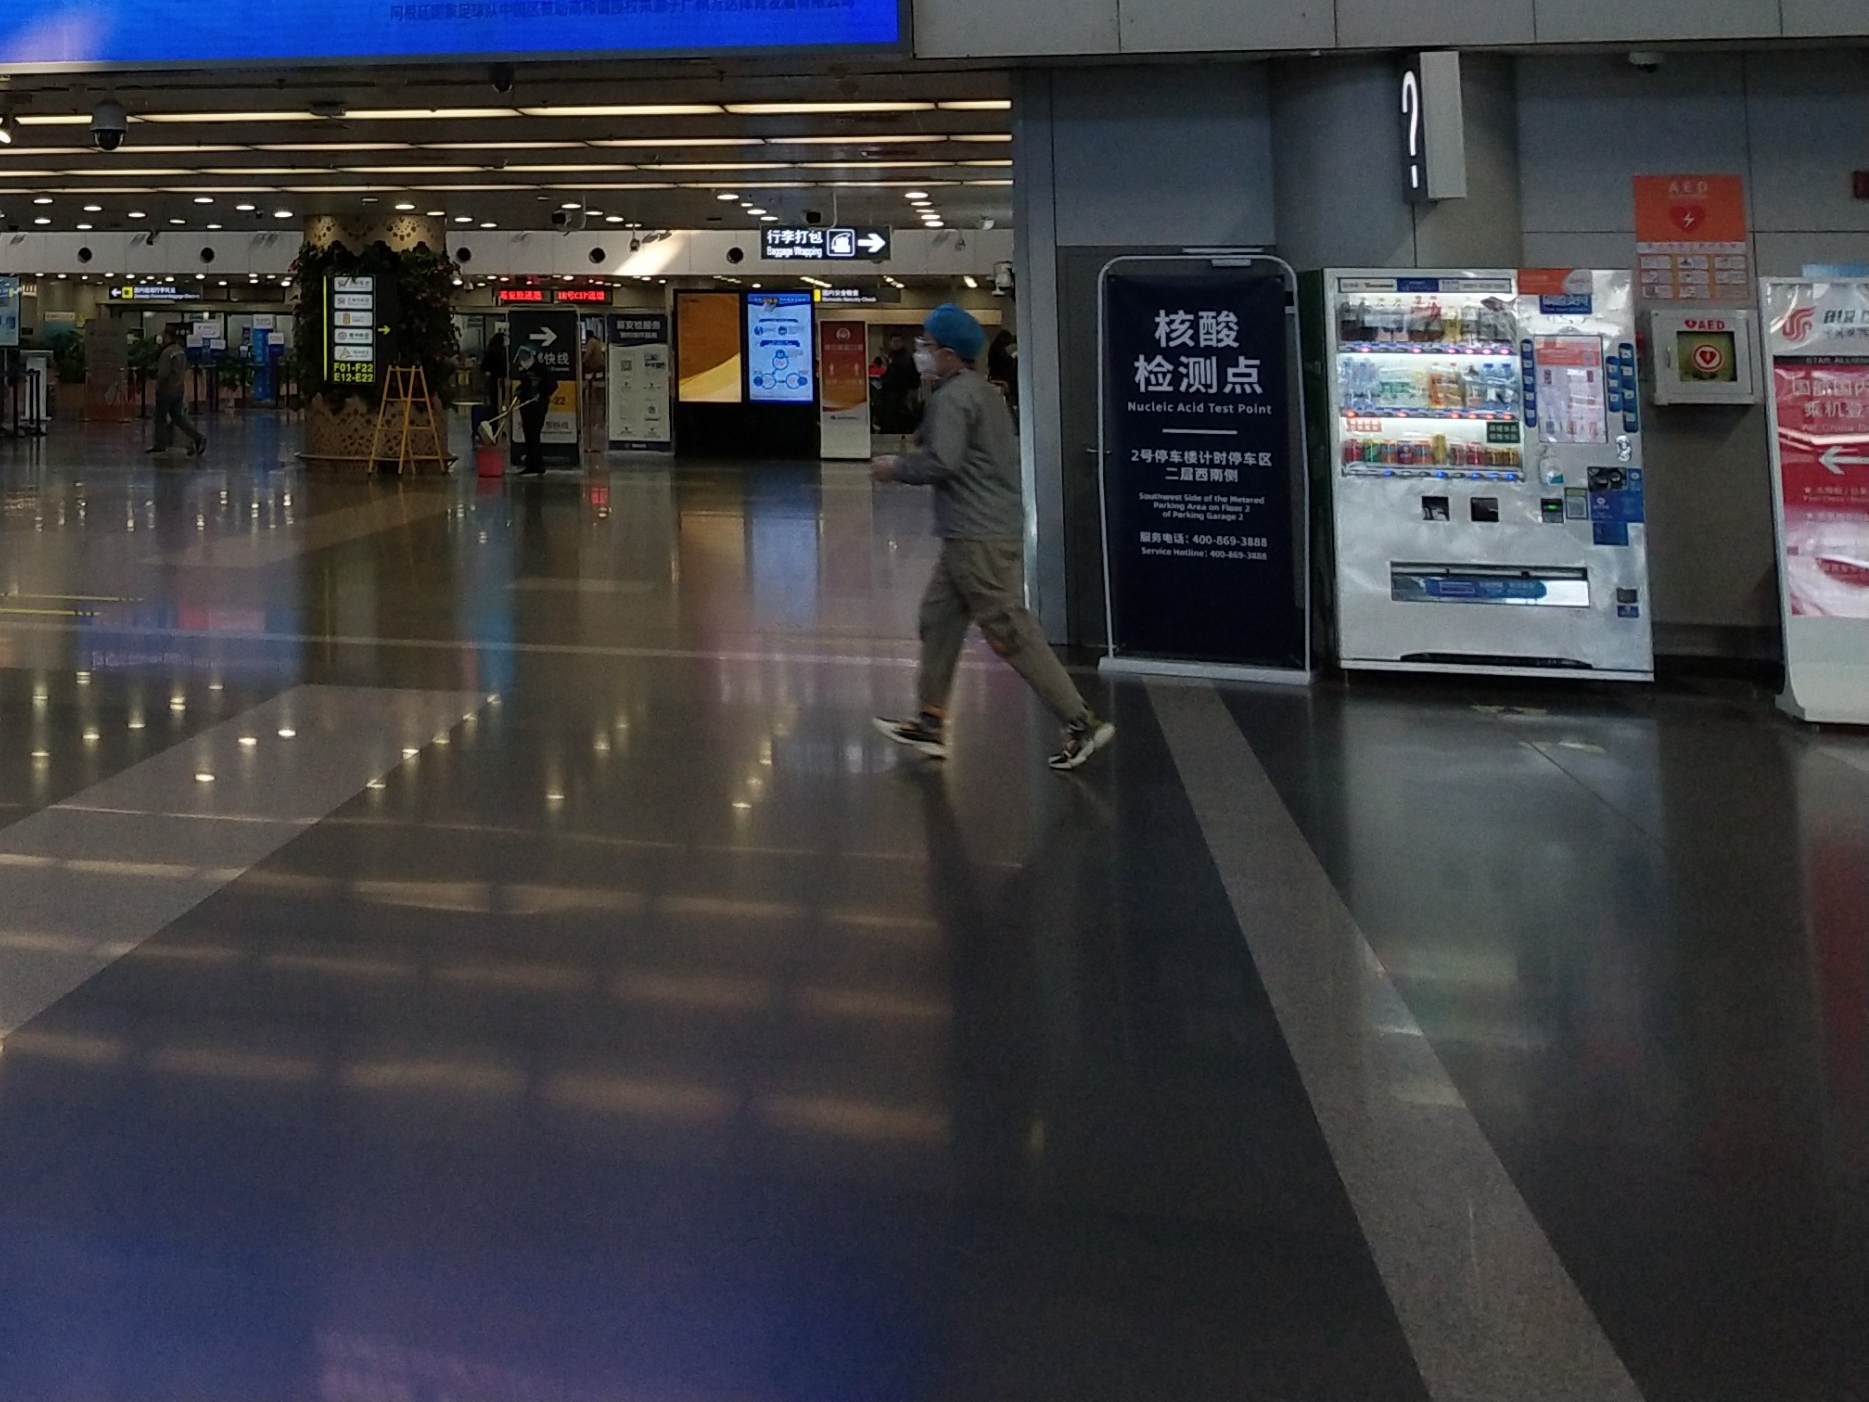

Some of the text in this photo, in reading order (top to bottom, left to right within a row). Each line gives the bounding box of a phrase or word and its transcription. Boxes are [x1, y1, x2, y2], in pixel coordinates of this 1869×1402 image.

[1668, 181, 1708, 194] AED
[766, 229, 824, 245] 行李打包
[1154, 309, 1240, 348] 核酸
[1698, 320, 1726, 330] AED
[333, 362, 374, 373] F01-F22
[333, 373, 374, 383] E12-E22
[1133, 354, 1263, 395] 检测点
[1127, 401, 1272, 415] Nucleic Acid Test Point
[1130, 448, 1272, 467] 2号停车楼计时停车区
[1165, 466, 1239, 482] 二层西南侧
[1153, 501, 1186, 511] Parking
[1186, 502, 1207, 511] Area
[1172, 510, 1205, 521] Parking
[1206, 512, 1237, 522] Garage
[1192, 534, 1268, 548] 400-869-3888
[1141, 547, 1172, 556] Service
